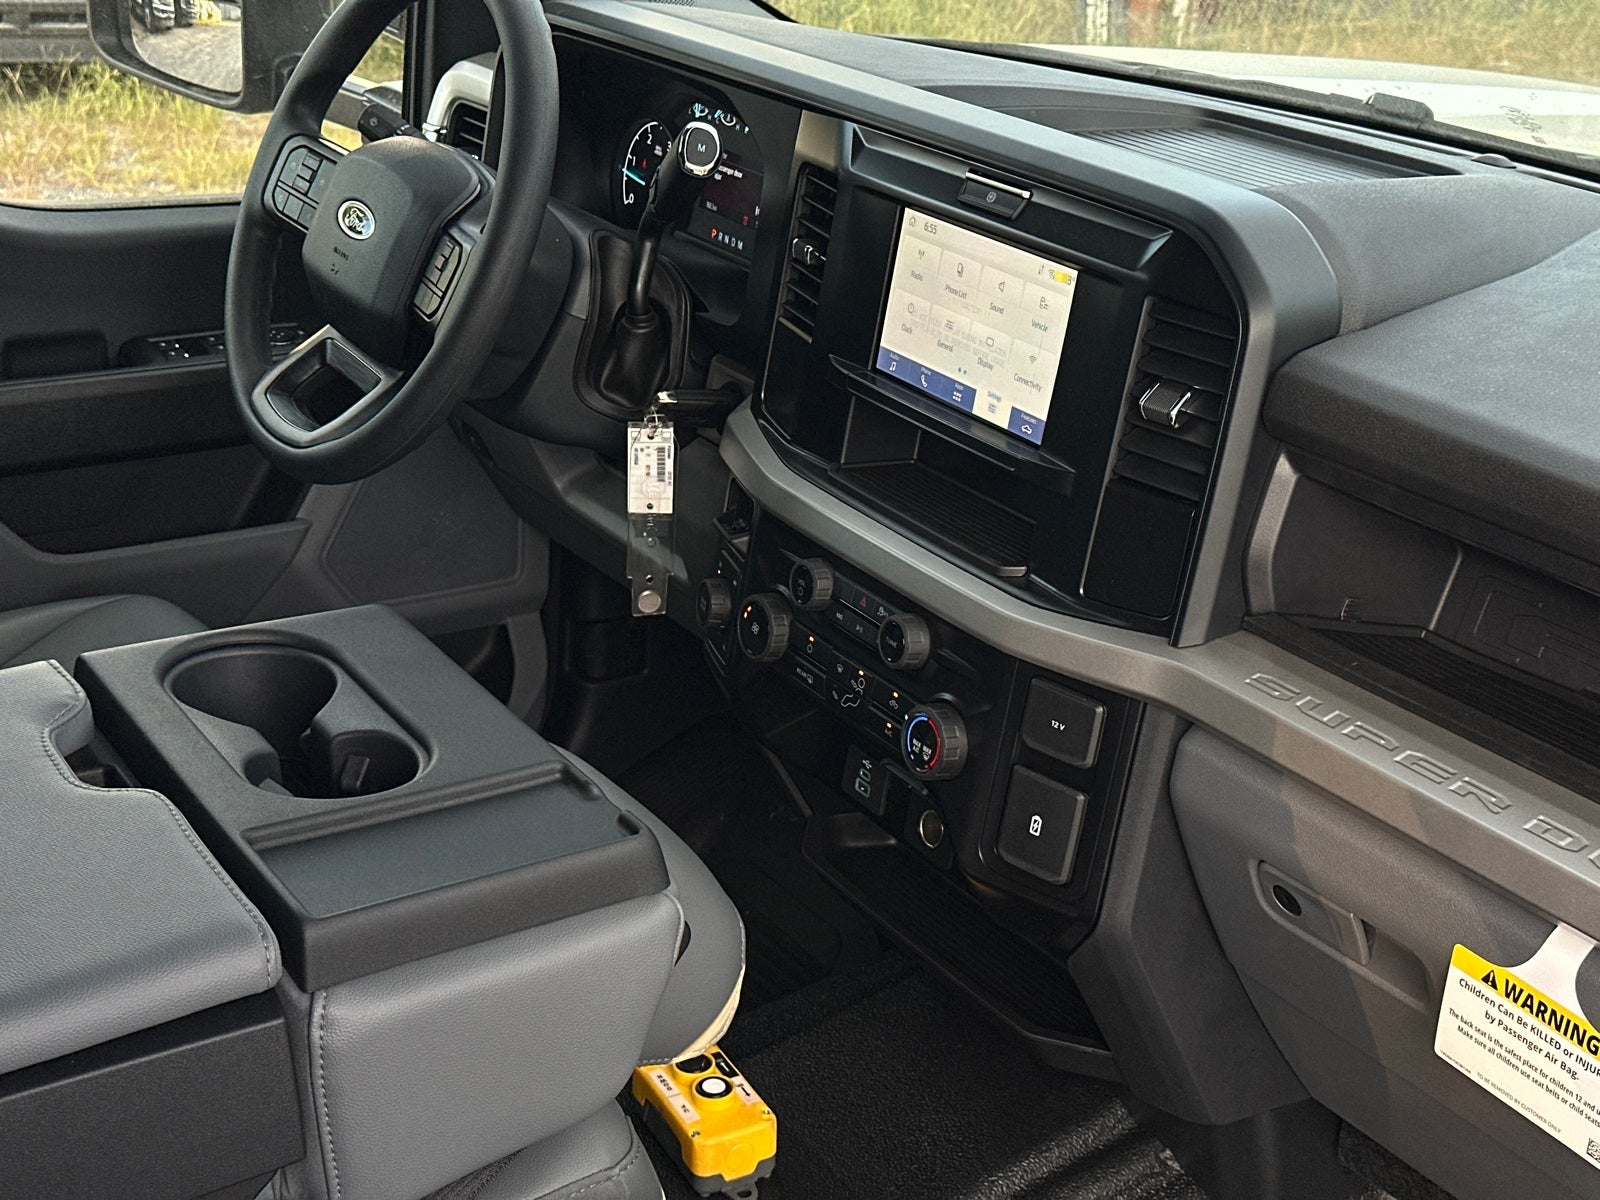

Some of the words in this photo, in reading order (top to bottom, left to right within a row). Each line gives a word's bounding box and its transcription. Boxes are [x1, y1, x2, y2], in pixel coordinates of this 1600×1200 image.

[646, 134, 652, 144] 2
[697, 144, 706, 153] M
[628, 193, 634, 204] 0
[924, 222, 938, 235] 6:55
[911, 270, 924, 282] Radio
[944, 284, 960, 296] Phone
[960, 290, 968, 300] List
[989, 302, 1004, 315] Sound
[901, 323, 912, 334] Clock
[1031, 318, 1048, 333] Vehicle
[937, 339, 954, 353] General
[976, 356, 994, 371] Display
[1014, 373, 1043, 392] Connectivity
[1051, 720, 1060, 729] 12
[1244, 672, 1512, 815] SUPER
[1458, 978, 1496, 1008] Children
[1498, 1004, 1514, 1020] Can
[1516, 1016, 1528, 1030] Be
[1530, 1022, 1562, 1050] KILLED
[1563, 1048, 1574, 1058] or
[1504, 978, 1600, 1056] WARNING
[1484, 1010, 1496, 1024] by
[1498, 1018, 1544, 1054] Passenger
[1544, 1051, 1558, 1064] Air
[1560, 1060, 1580, 1080] Bag.
[1449, 1008, 1460, 1020] The
[1460, 1015, 1474, 1030] back
[1474, 1026, 1487, 1038] seat
[1488, 1034, 1493, 1042] is
[1494, 1038, 1504, 1050] the
[1504, 1046, 1522, 1062] safest
[1522, 1060, 1538, 1074] place
[1540, 1068, 1549, 1080] for
[1550, 1077, 1574, 1098] children
[1575, 1094, 1582, 1104] 12
[1583, 1100, 1596, 1112] and
[1457, 1024, 1474, 1040] Make
[1474, 1038, 1487, 1050] sure
[1488, 1046, 1496, 1056] all
[1496, 1052, 1520, 1072] children
[1520, 1069, 1530, 1080] use
[1532, 1077, 1544, 1090] seat
[1545, 1084, 1560, 1100] belts
[1560, 1097, 1568, 1105] or
[1568, 1102, 1584, 1116] child
[1477, 1072, 1484, 1080] TO
[1484, 1076, 1490, 1084] BE
[1490, 1081, 1514, 1100] REMOVED
[1514, 1097, 1520, 1106] BY
[1520, 1102, 1547, 1123] CUSTOMER
[1548, 1120, 1562, 1134] ONLY
